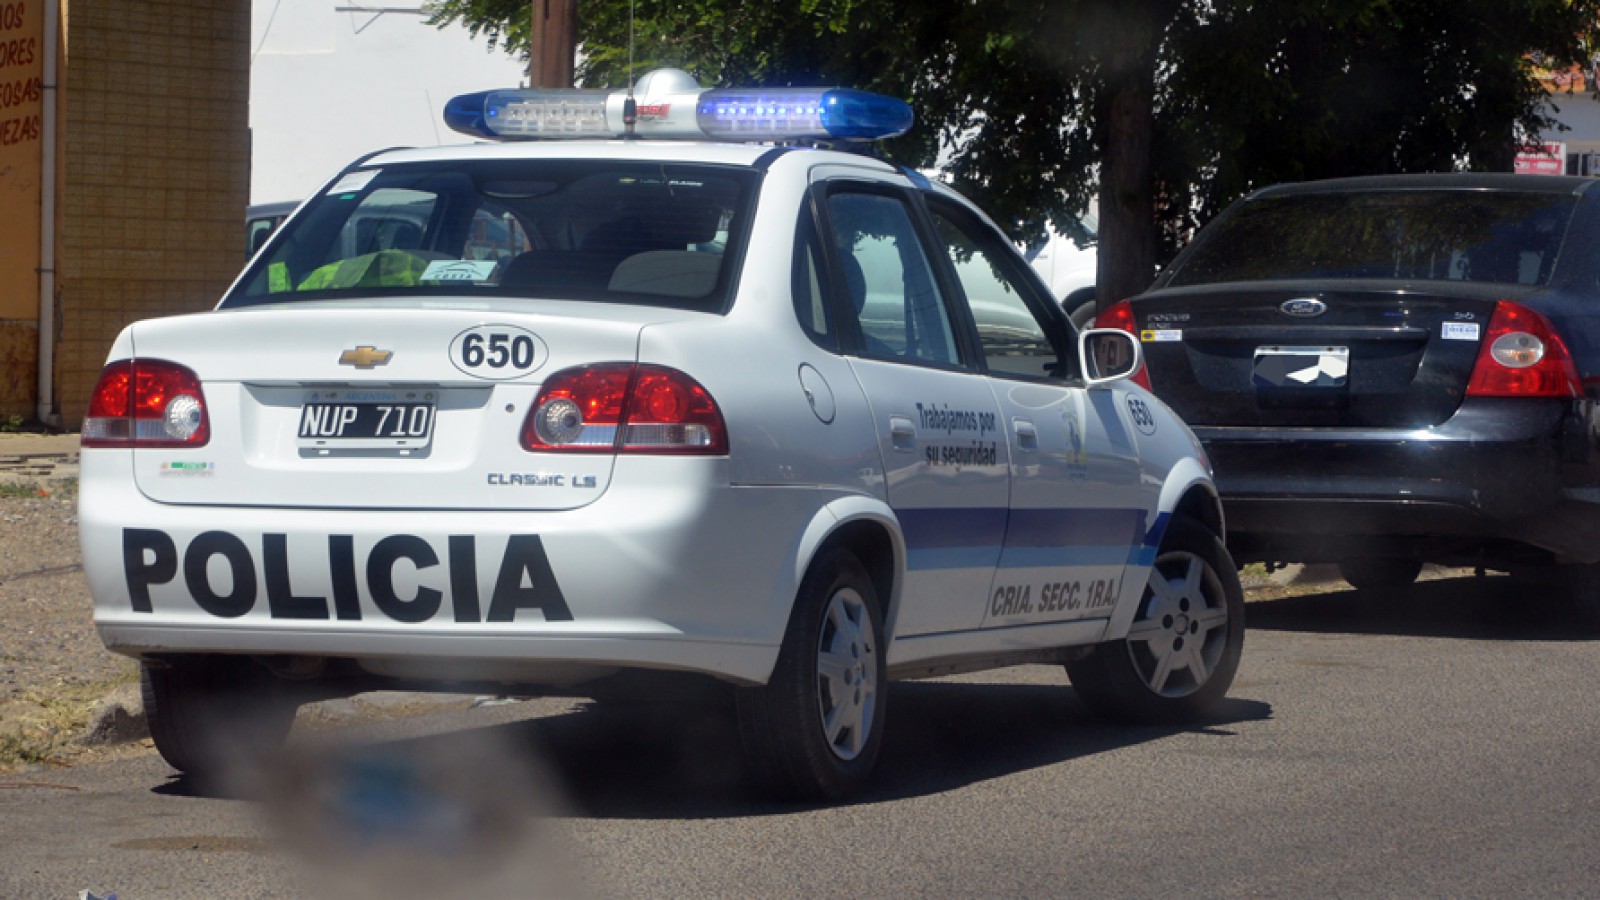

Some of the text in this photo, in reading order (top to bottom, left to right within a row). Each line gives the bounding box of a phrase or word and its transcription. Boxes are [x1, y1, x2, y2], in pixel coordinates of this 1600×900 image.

[462, 333, 534, 369] 650
[301, 405, 428, 436] NUP 710
[915, 402, 996, 436] Trabajamos por
[1127, 399, 1153, 426] 650
[926, 439, 996, 472] su seguridad
[487, 473, 596, 488] CLASSIC LS
[122, 527, 574, 622] POLICIA
[992, 578, 1114, 617] CRIA. SECC. 1RA.
